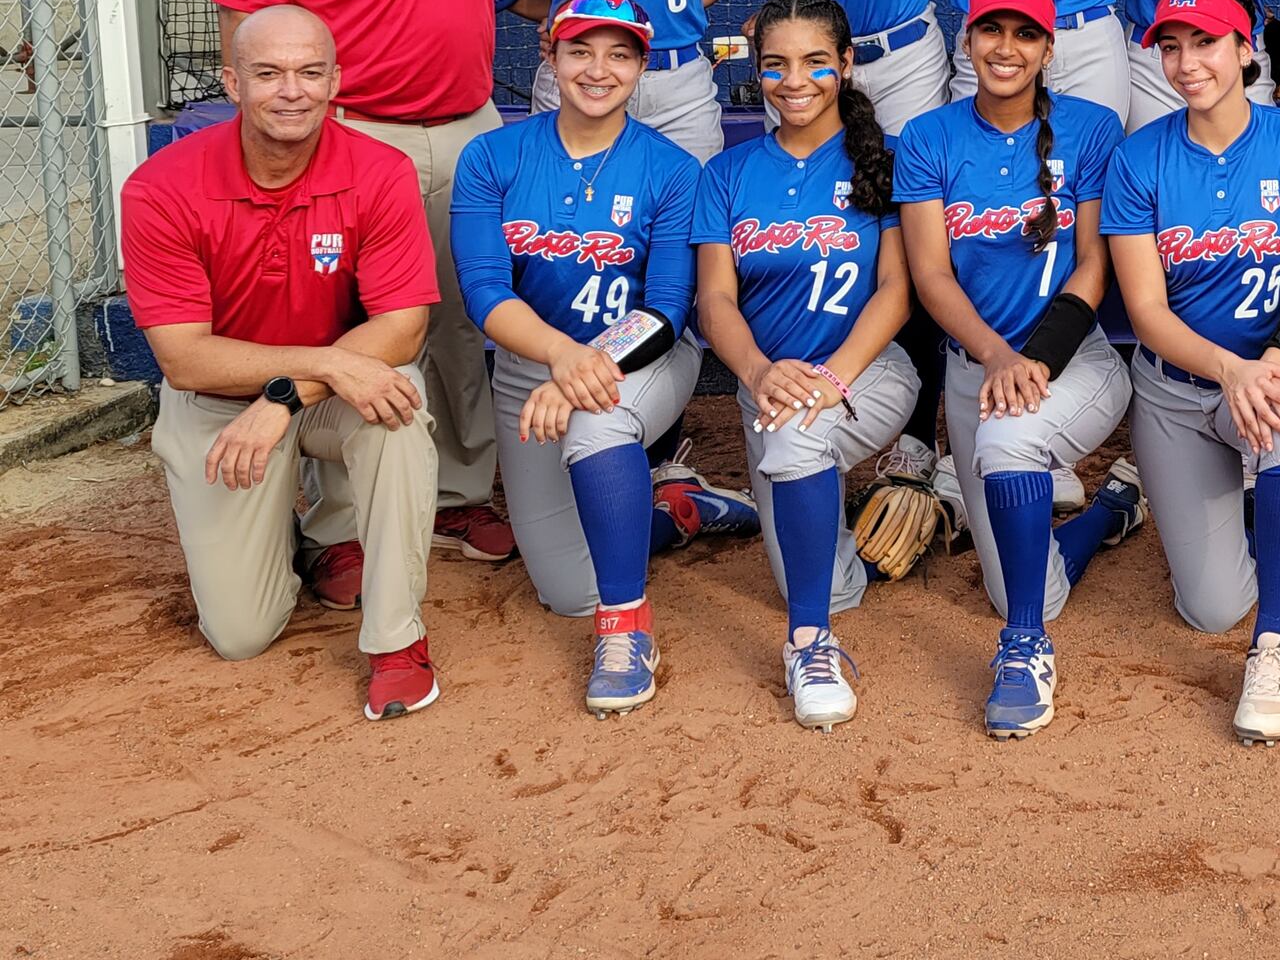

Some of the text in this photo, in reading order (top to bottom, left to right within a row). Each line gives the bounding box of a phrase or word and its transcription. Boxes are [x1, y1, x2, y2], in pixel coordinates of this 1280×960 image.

[311, 233, 343, 248] PUR
[502, 221, 635, 271] Puerto Rico
[732, 215, 860, 259] Puerto Rico
[1156, 226, 1239, 271] Puerto
[571, 275, 628, 325] 49
[806, 260, 860, 315] 12
[600, 616, 619, 629] 917
